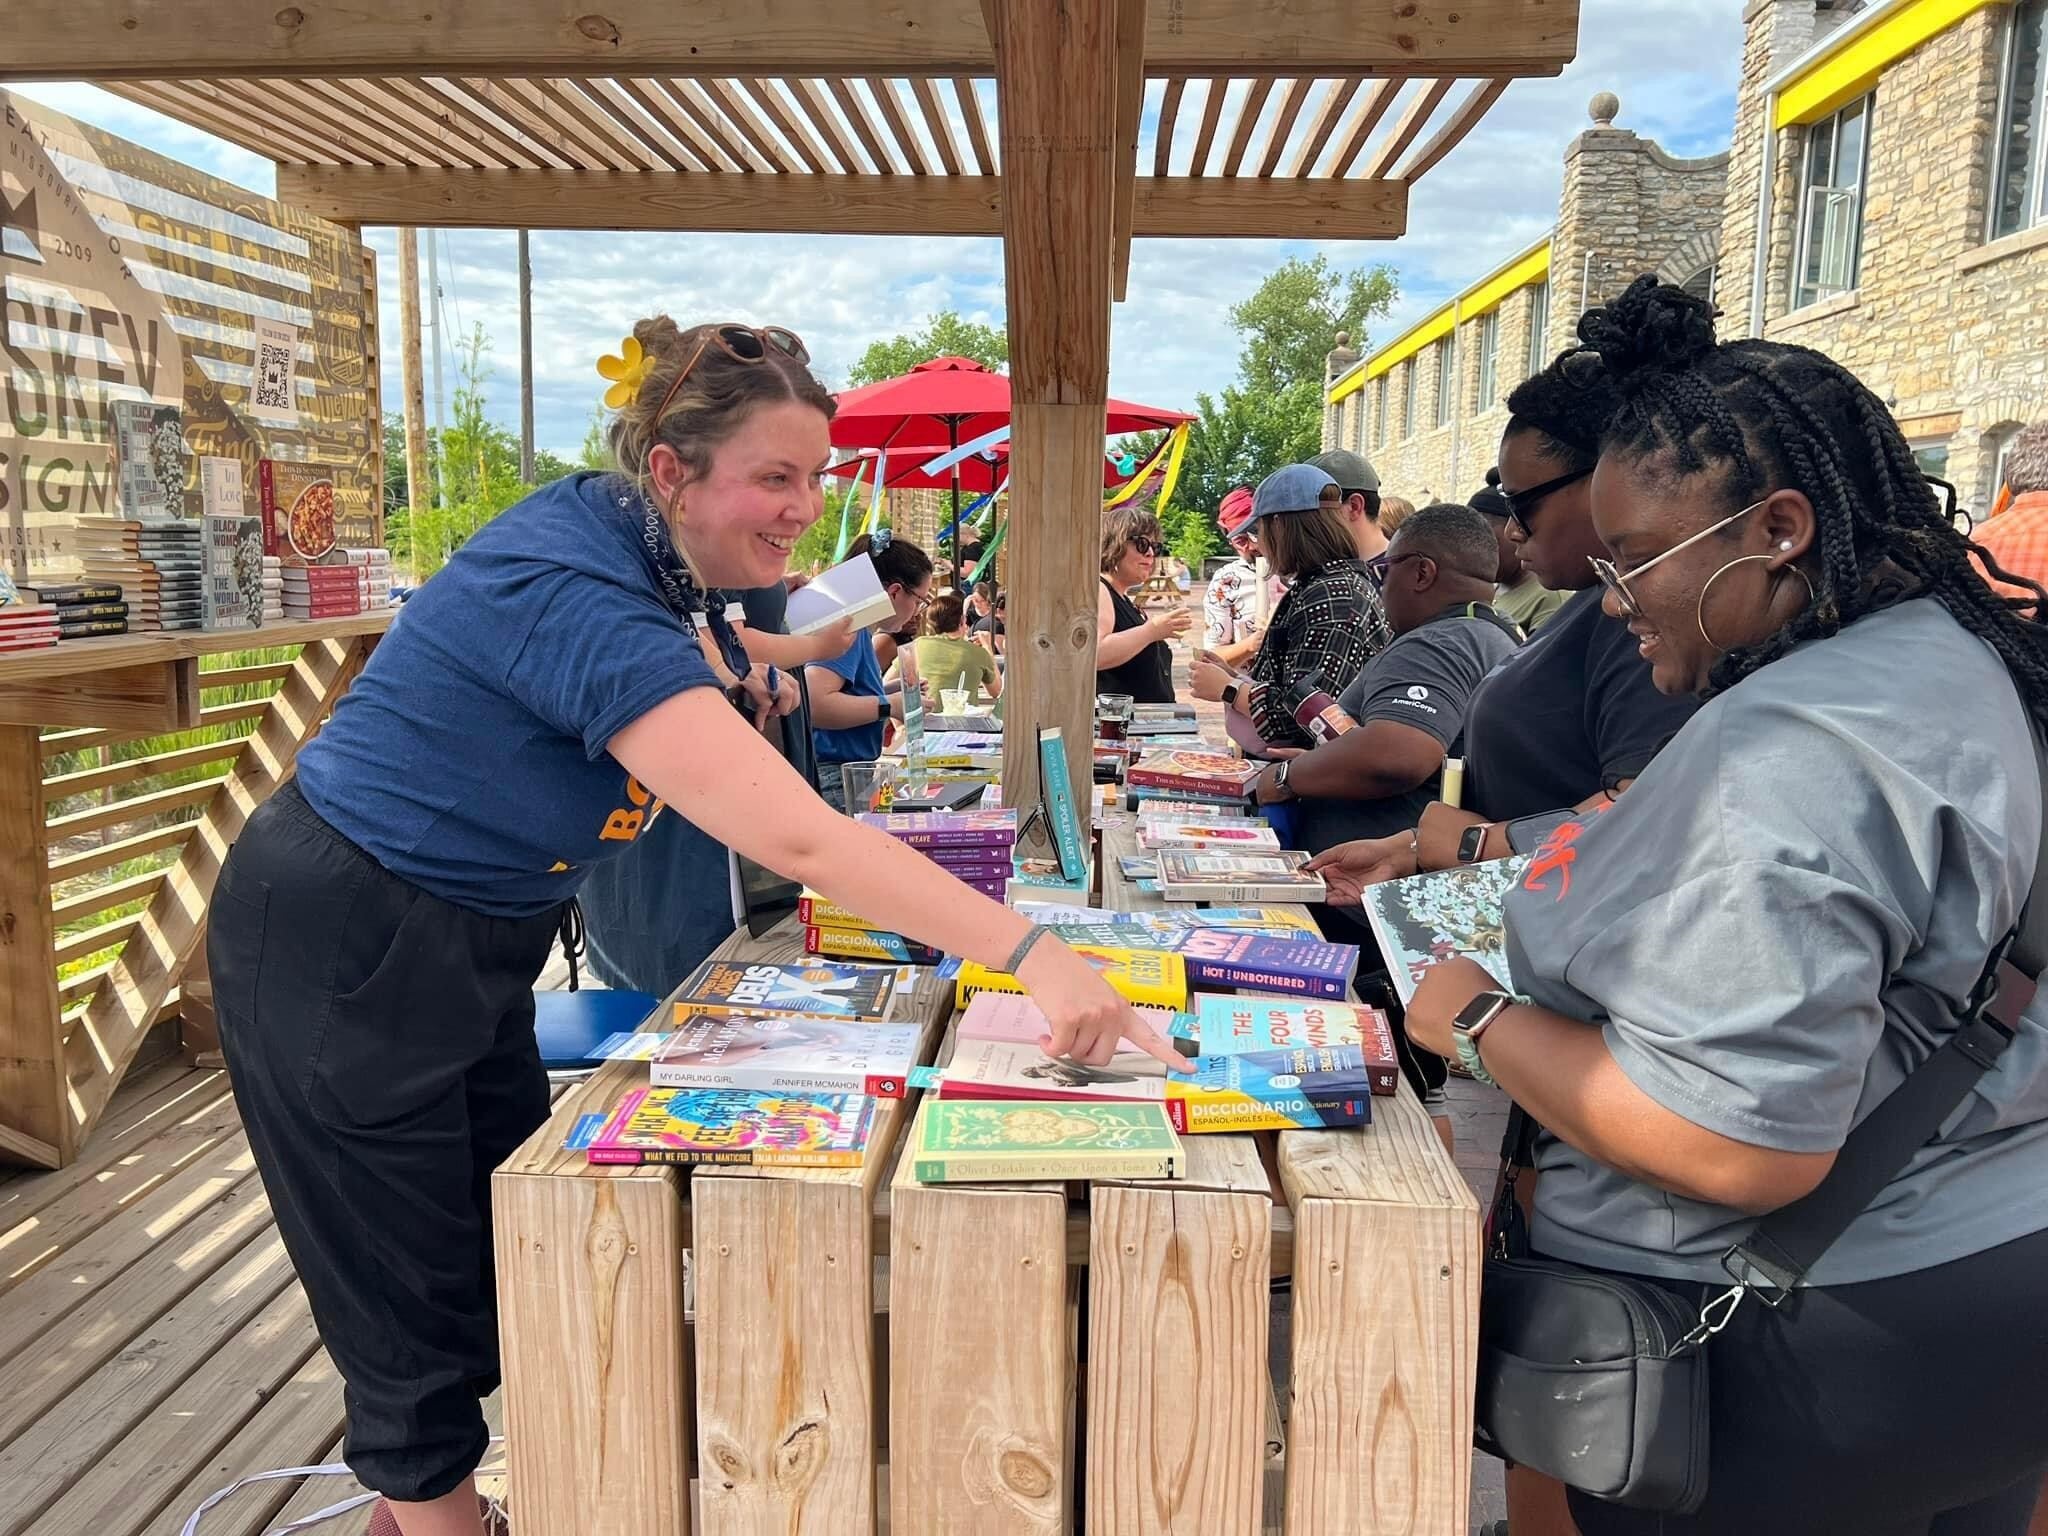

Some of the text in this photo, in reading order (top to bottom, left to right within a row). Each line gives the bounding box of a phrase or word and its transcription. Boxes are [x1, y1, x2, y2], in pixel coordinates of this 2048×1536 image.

[56, 238, 92, 262] 2009
[213, 520, 237, 532] BLACK
[214, 578, 229, 590] THE
[214, 592, 240, 604] WORLD
[1392, 698, 1437, 714] AmeriCorps
[908, 835, 931, 843] WEAVE
[1058, 803, 1076, 860] SPOILER ALERT
[823, 933, 900, 949] DICCIONARIO
[714, 969, 742, 998] JONES
[726, 965, 781, 1004] DEUS
[1202, 965, 1225, 979] HOT
[1232, 972, 1306, 989] UNBOTHERED
[1233, 1012, 1253, 1036] THE
[1268, 1010, 1291, 1046] FOUR
[1378, 1034, 1395, 1062] Kristin
[660, 1072, 734, 1083] MY DARLING GIRL
[772, 1078, 859, 1089] JENNIFER MCMAHON
[1174, 1102, 1182, 1131] Collins
[1191, 1100, 1304, 1117] DICCIONARIO
[644, 1152, 662, 1162] WHAT
[664, 1152, 676, 1162] WE
[677, 1152, 689, 1162] FED
[691, 1153, 700, 1162] TO
[702, 1153, 713, 1162] THE
[715, 1153, 752, 1163] MANTICORE
[957, 1164, 989, 1174] Oliver
[1050, 1163, 1079, 1173] Once
[1081, 1163, 1109, 1175] Upon
[1121, 1162, 1146, 1172] Tome
